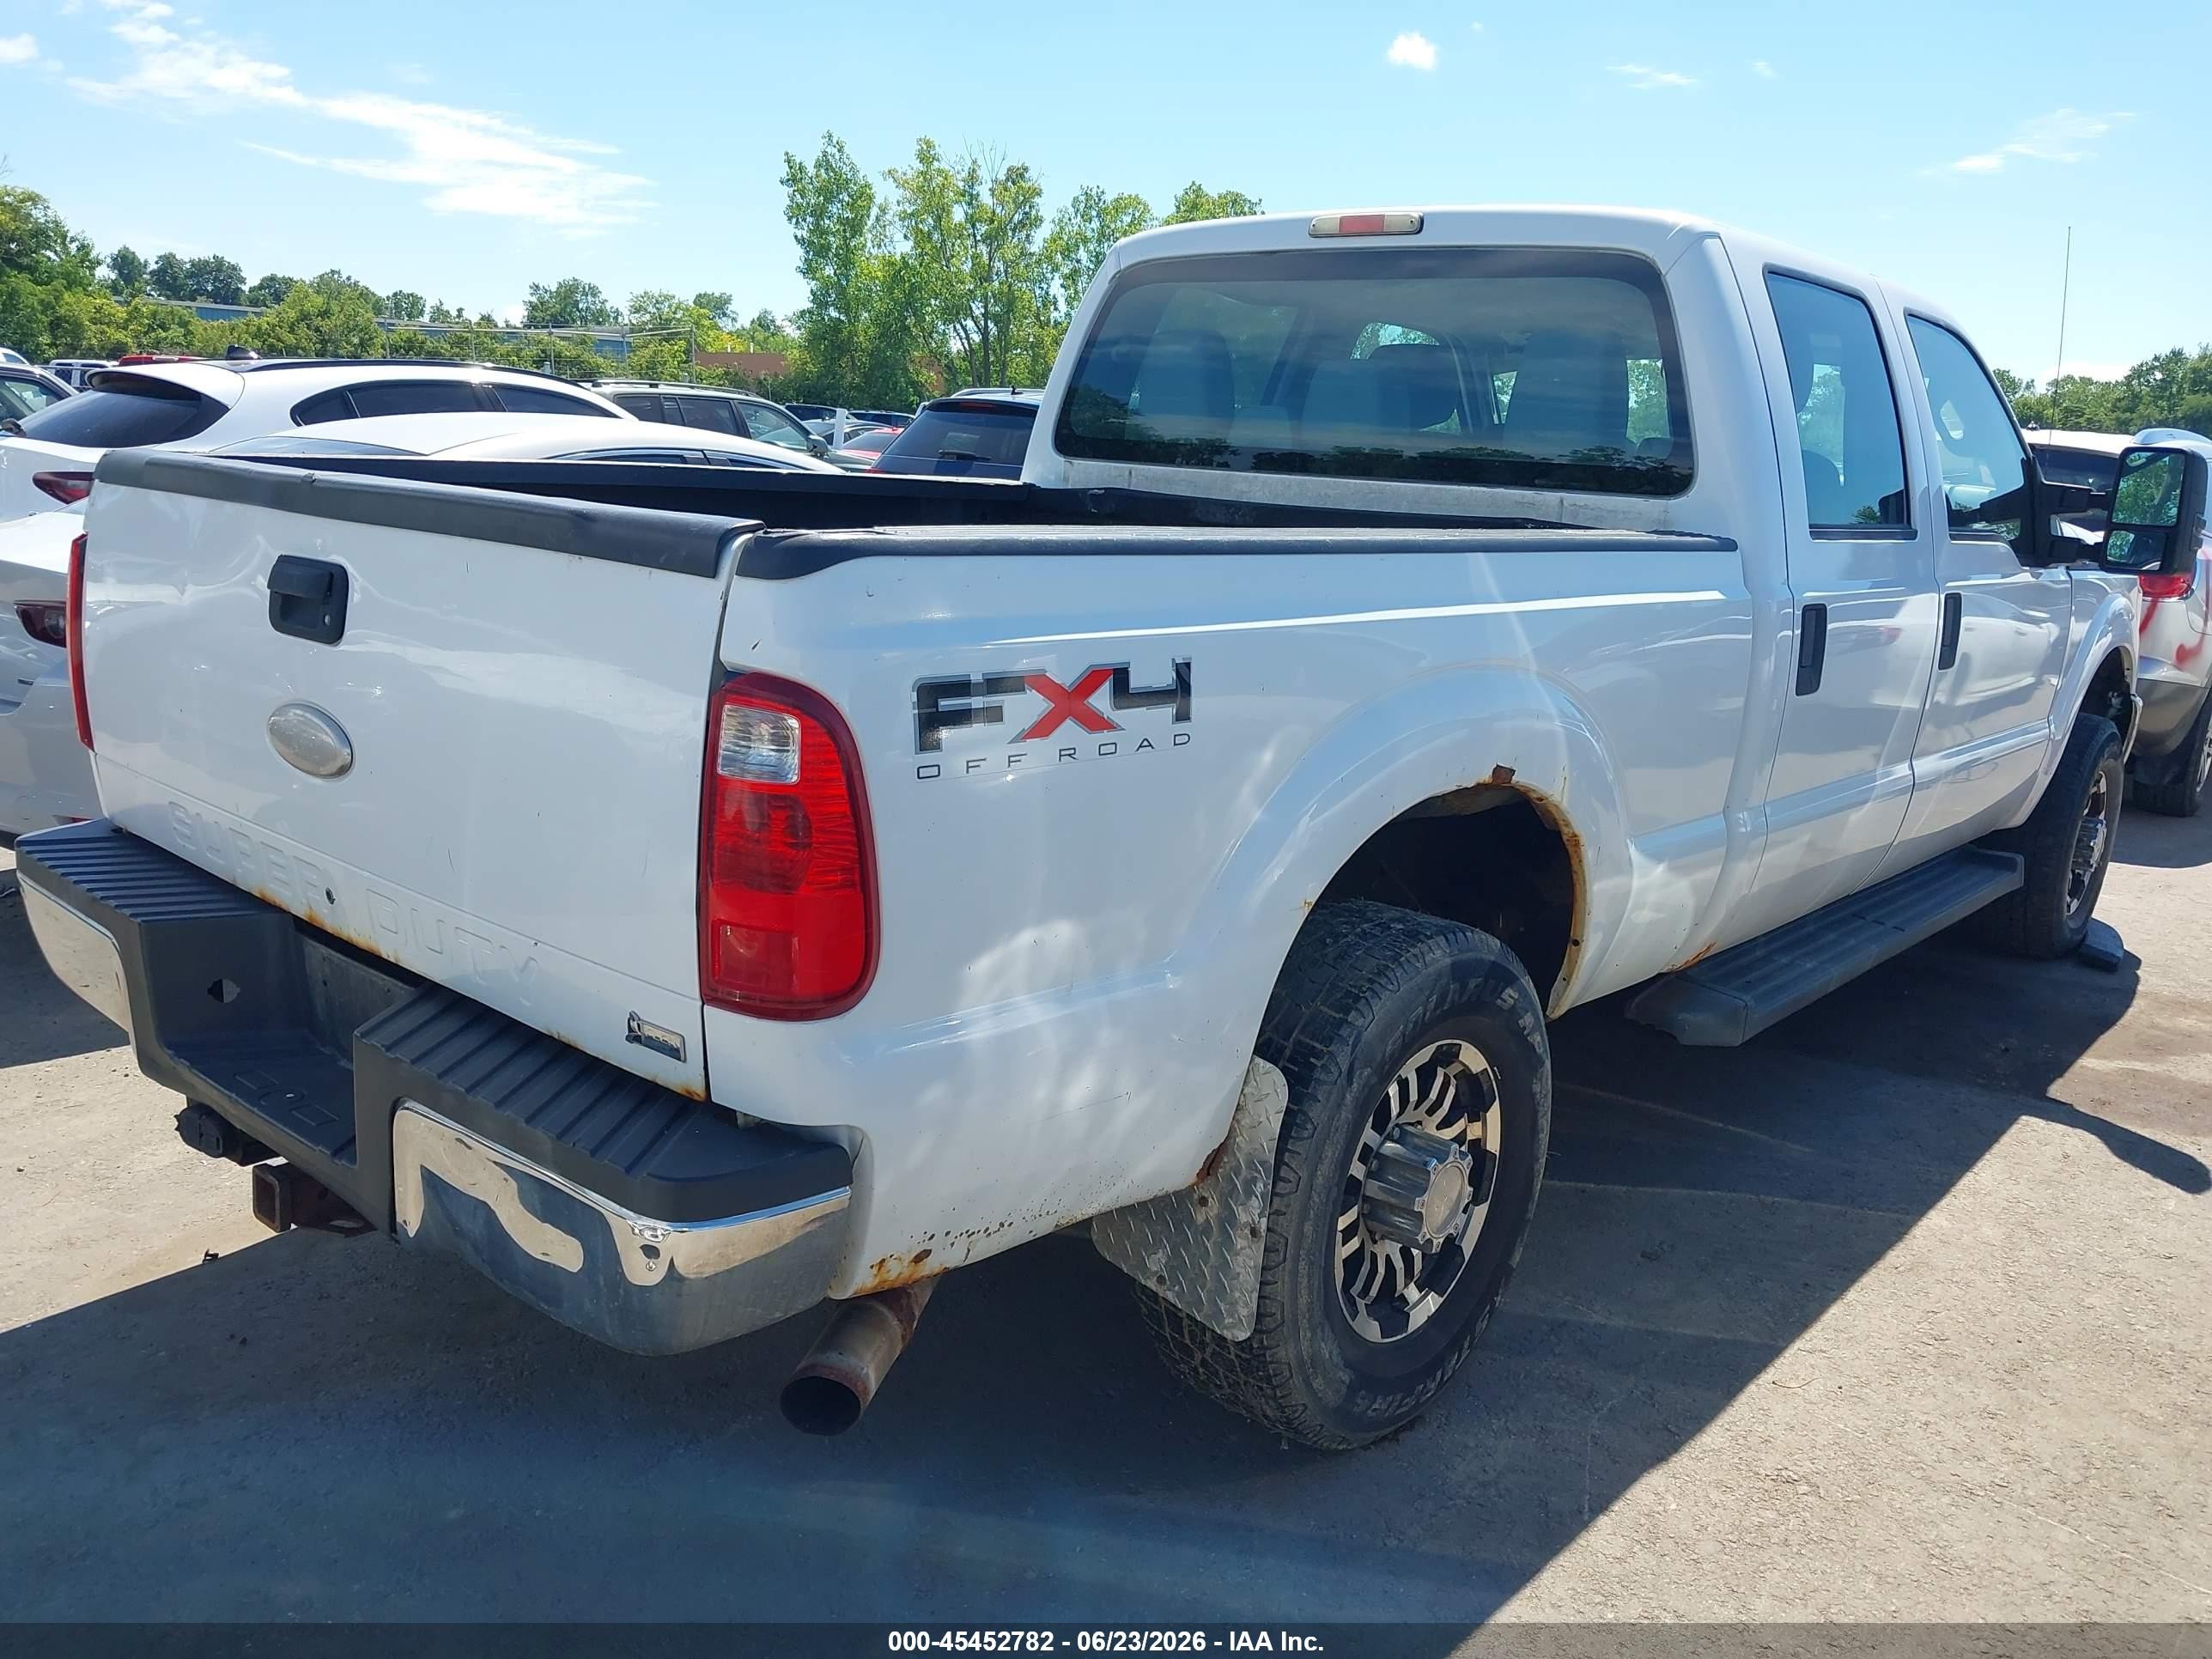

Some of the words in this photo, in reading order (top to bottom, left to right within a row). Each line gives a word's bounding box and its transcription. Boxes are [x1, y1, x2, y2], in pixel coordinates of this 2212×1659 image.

[911, 657, 1193, 755] FX4
[915, 752, 1028, 780] OFF
[1058, 732, 1192, 763] ROAD
[168, 800, 335, 914] SUPER
[365, 887, 539, 1007] DUTY
